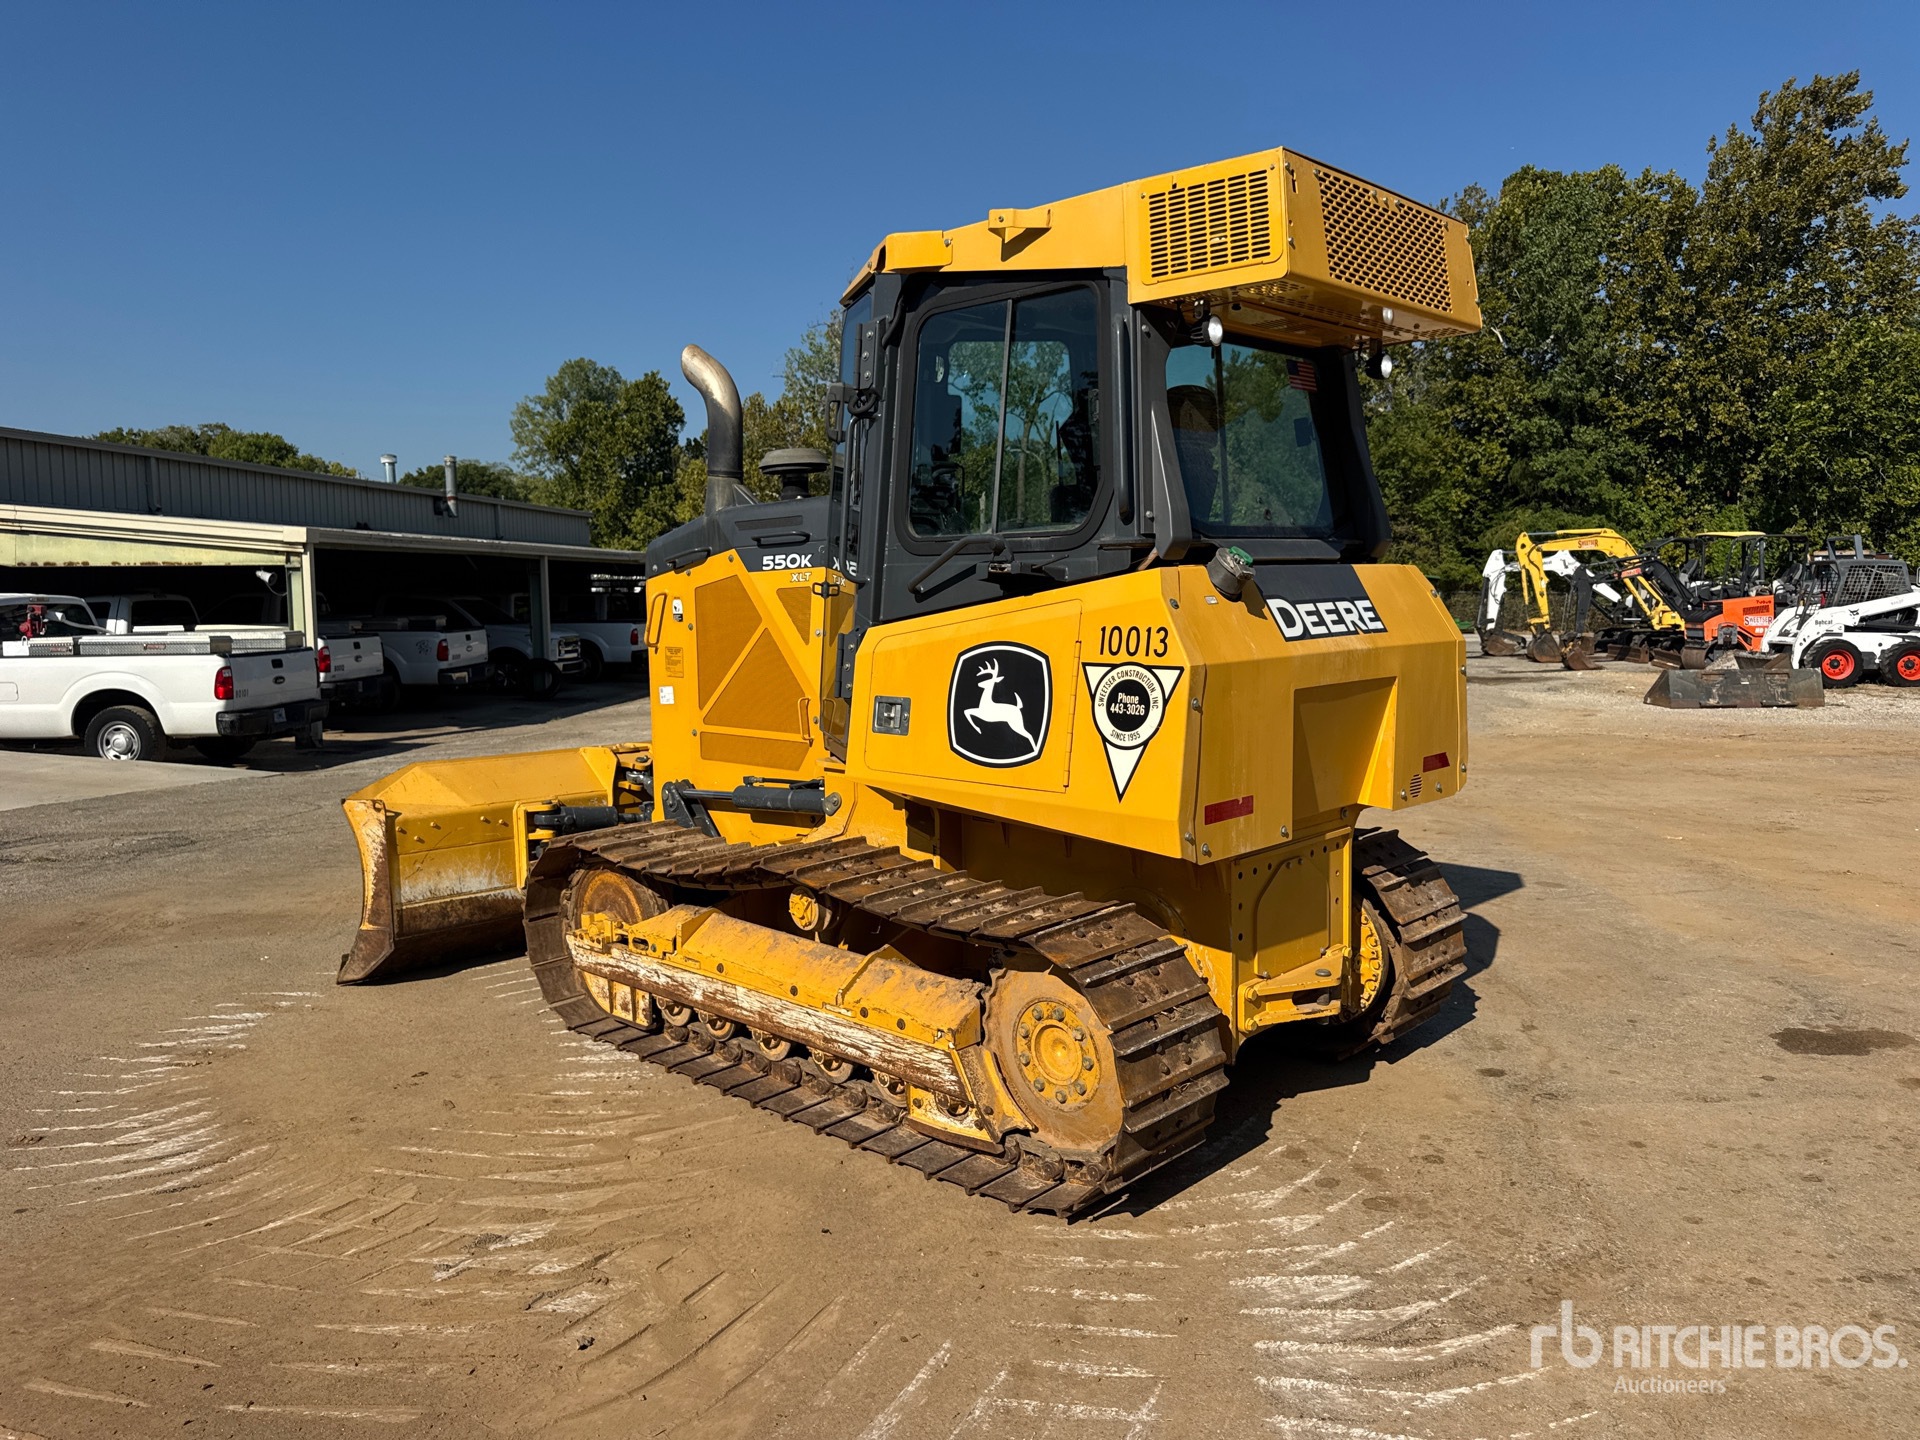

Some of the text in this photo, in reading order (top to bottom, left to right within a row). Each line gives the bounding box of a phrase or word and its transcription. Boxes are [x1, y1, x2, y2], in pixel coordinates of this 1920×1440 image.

[762, 553, 812, 570] 550K
[791, 572, 811, 582] XLT
[1266, 599, 1384, 638] DEERE
[1099, 626, 1169, 658] 10013
[1098, 675, 1117, 707] SWEETSER
[1117, 692, 1139, 704] Phone
[1110, 703, 1145, 716] 443-3026
[1110, 729, 1141, 742] SINCE 1955
